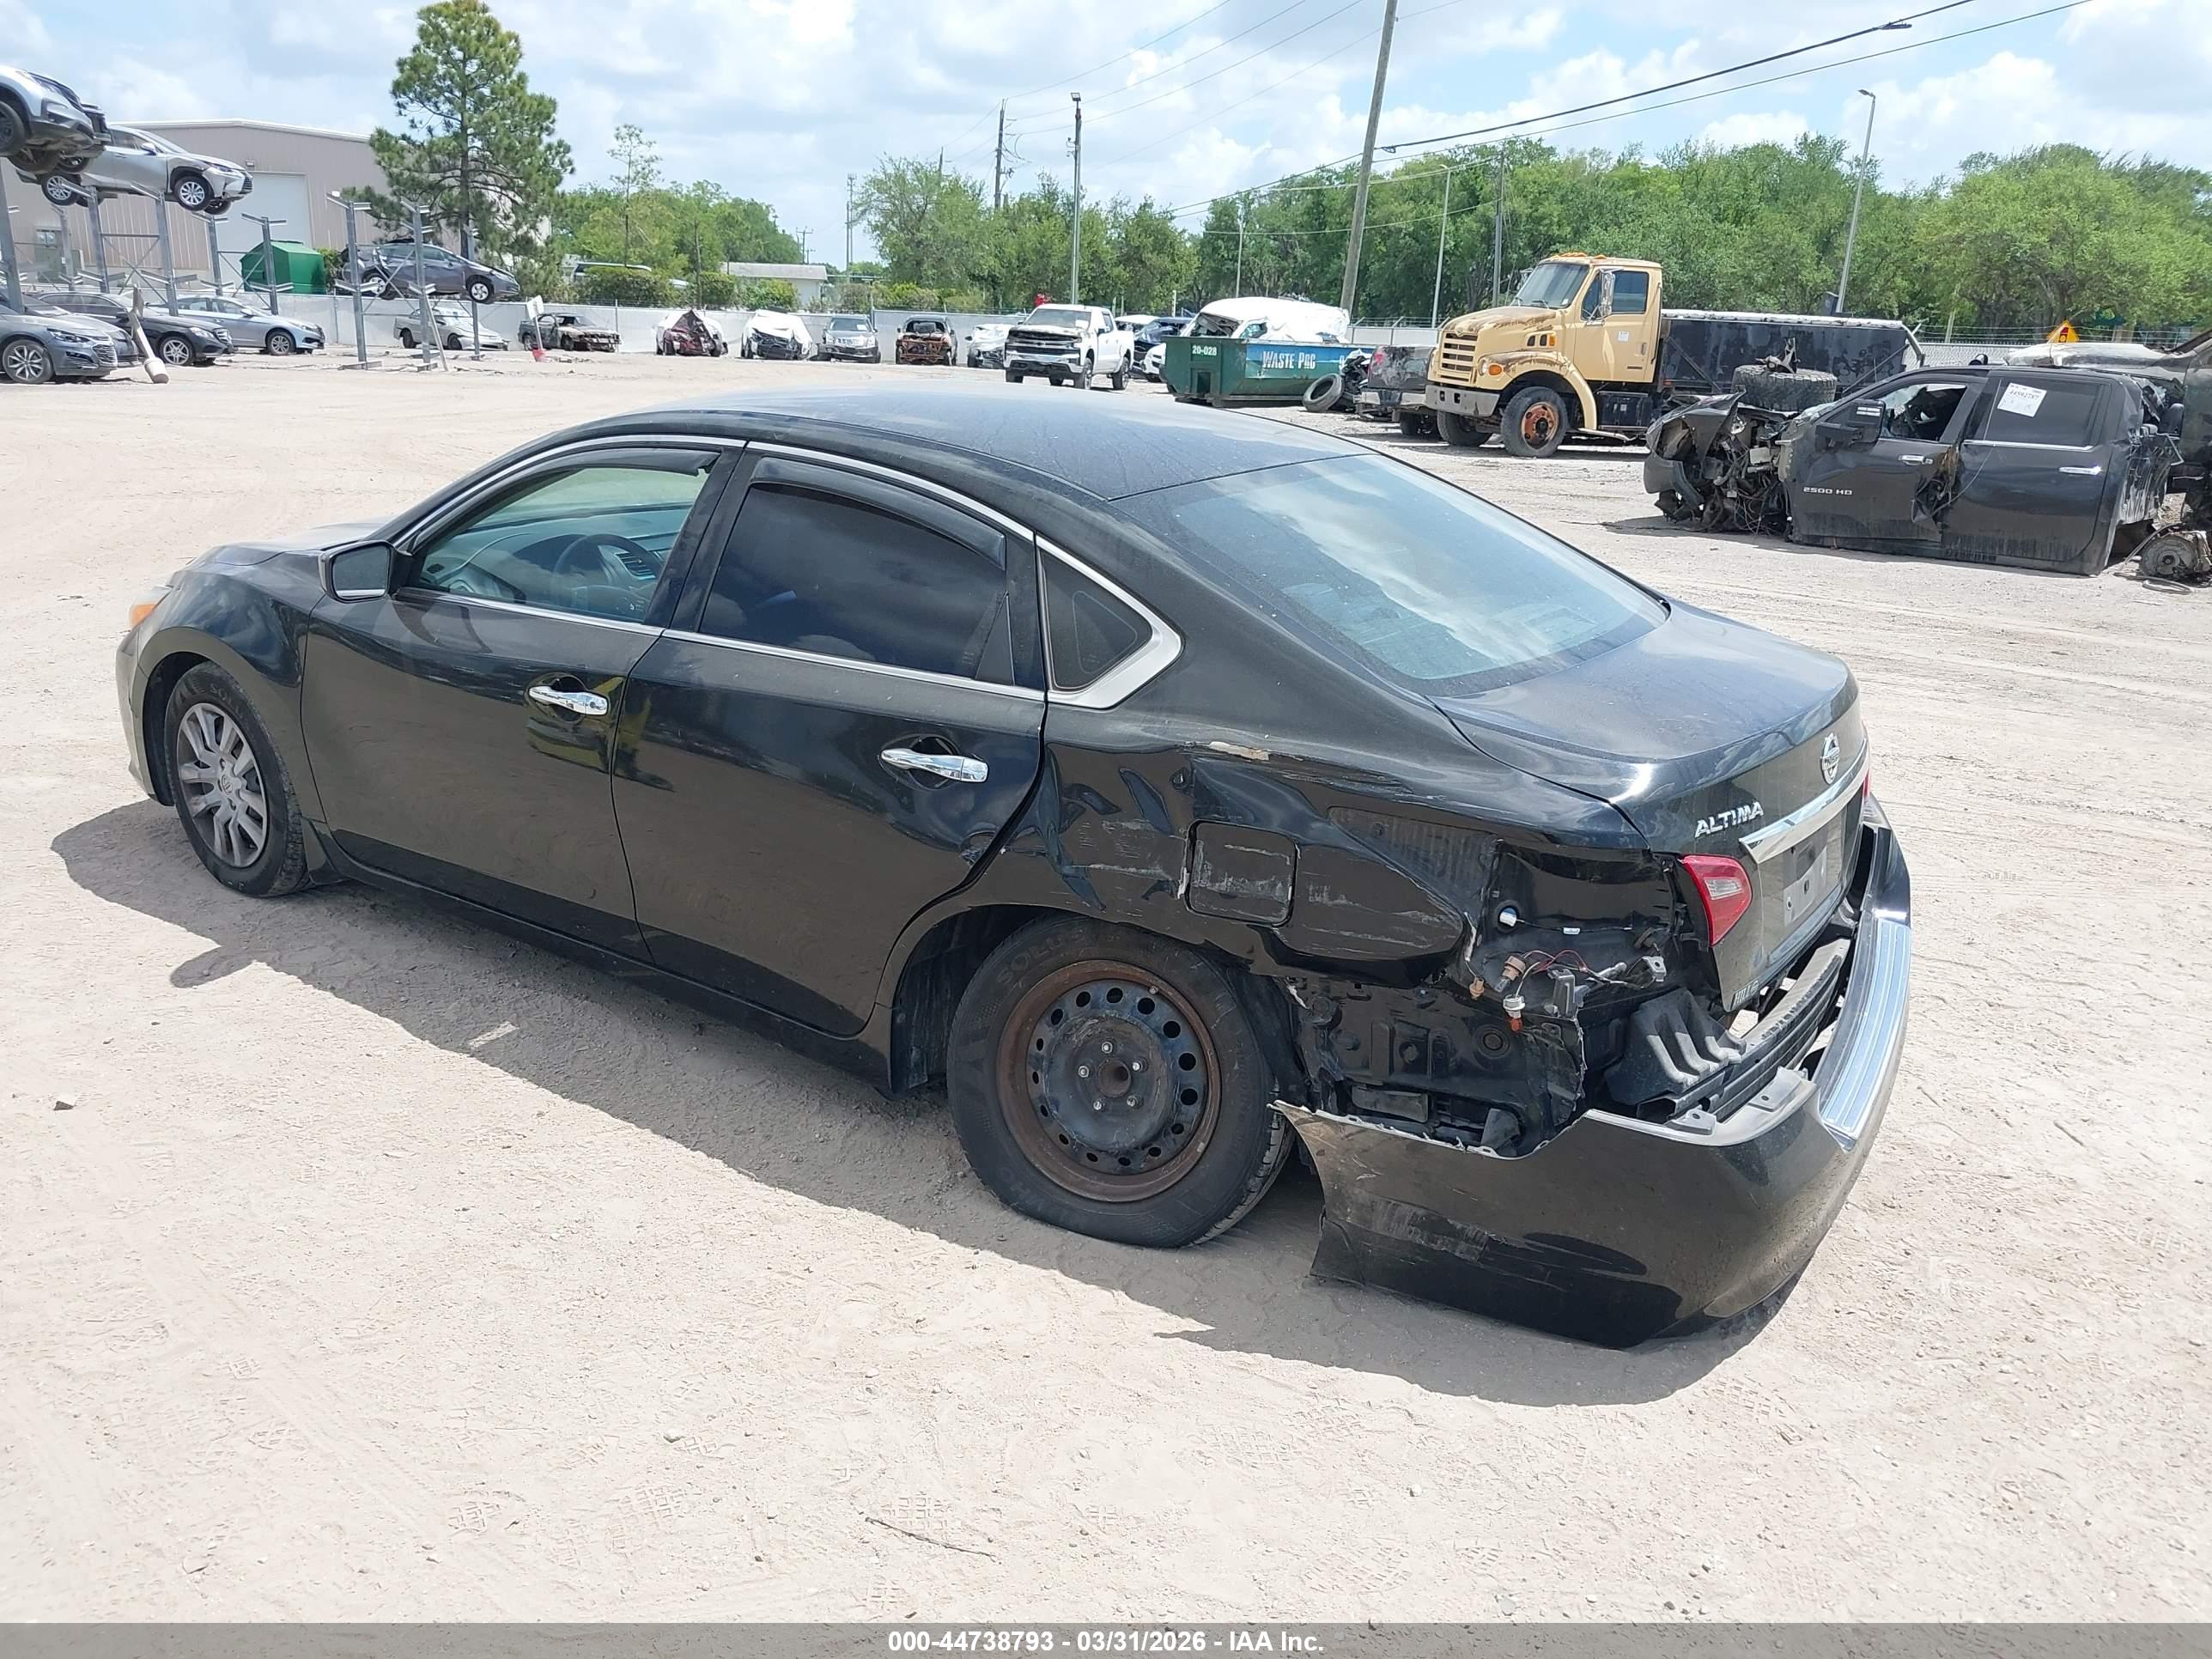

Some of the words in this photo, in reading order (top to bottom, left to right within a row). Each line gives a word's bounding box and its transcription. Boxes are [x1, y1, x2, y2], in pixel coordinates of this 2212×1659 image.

[1192, 345, 1218, 356] 20-028
[1262, 350, 1295, 368] WASTE
[1803, 486, 1832, 495] 2500
[1694, 800, 1764, 838] ALTIMA
